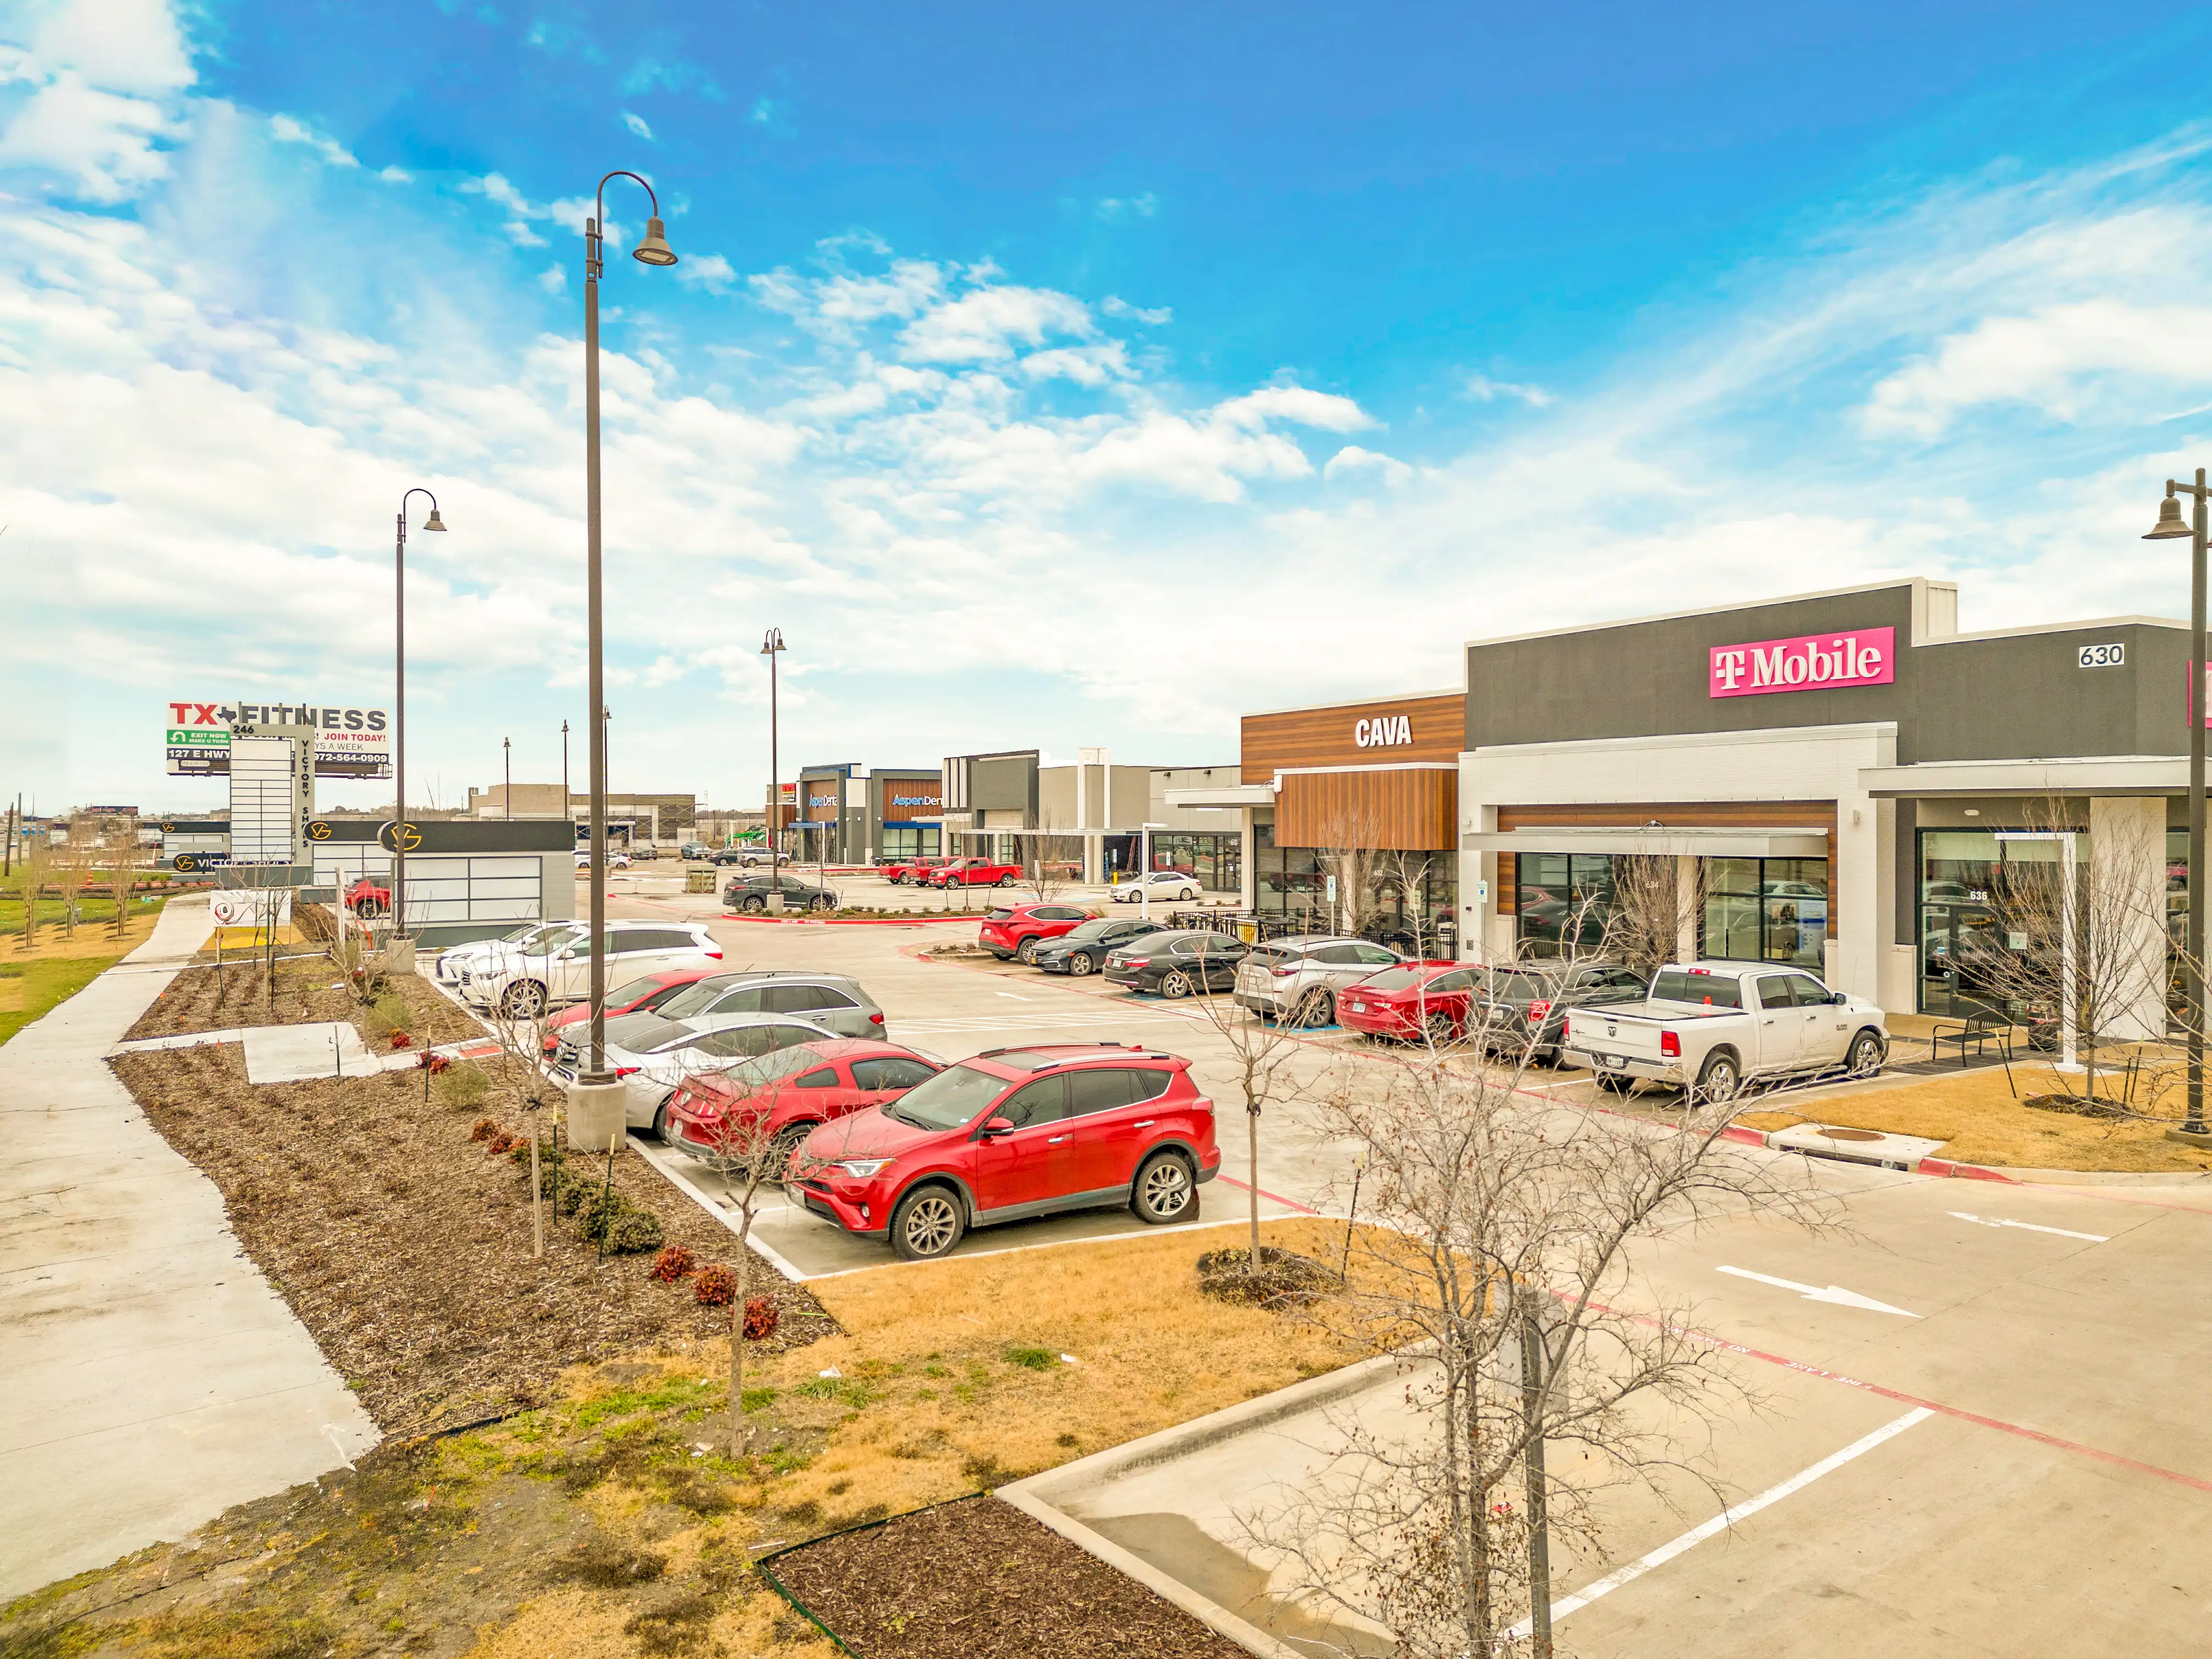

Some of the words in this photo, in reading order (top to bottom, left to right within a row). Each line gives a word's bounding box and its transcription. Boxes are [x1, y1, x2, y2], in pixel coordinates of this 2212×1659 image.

[2080, 645, 2123, 665] 630
[1751, 637, 1882, 687] Mobile
[170, 703, 218, 725] TX
[242, 706, 386, 731] FITNESS
[234, 725, 254, 733] 246
[1355, 715, 1412, 747] CAVA
[204, 750, 230, 758] HWY
[315, 753, 387, 763] 972-564-0909
[893, 793, 943, 807] AspenDen
[198, 859, 238, 867] VICTO
[1970, 891, 1988, 900] 636
